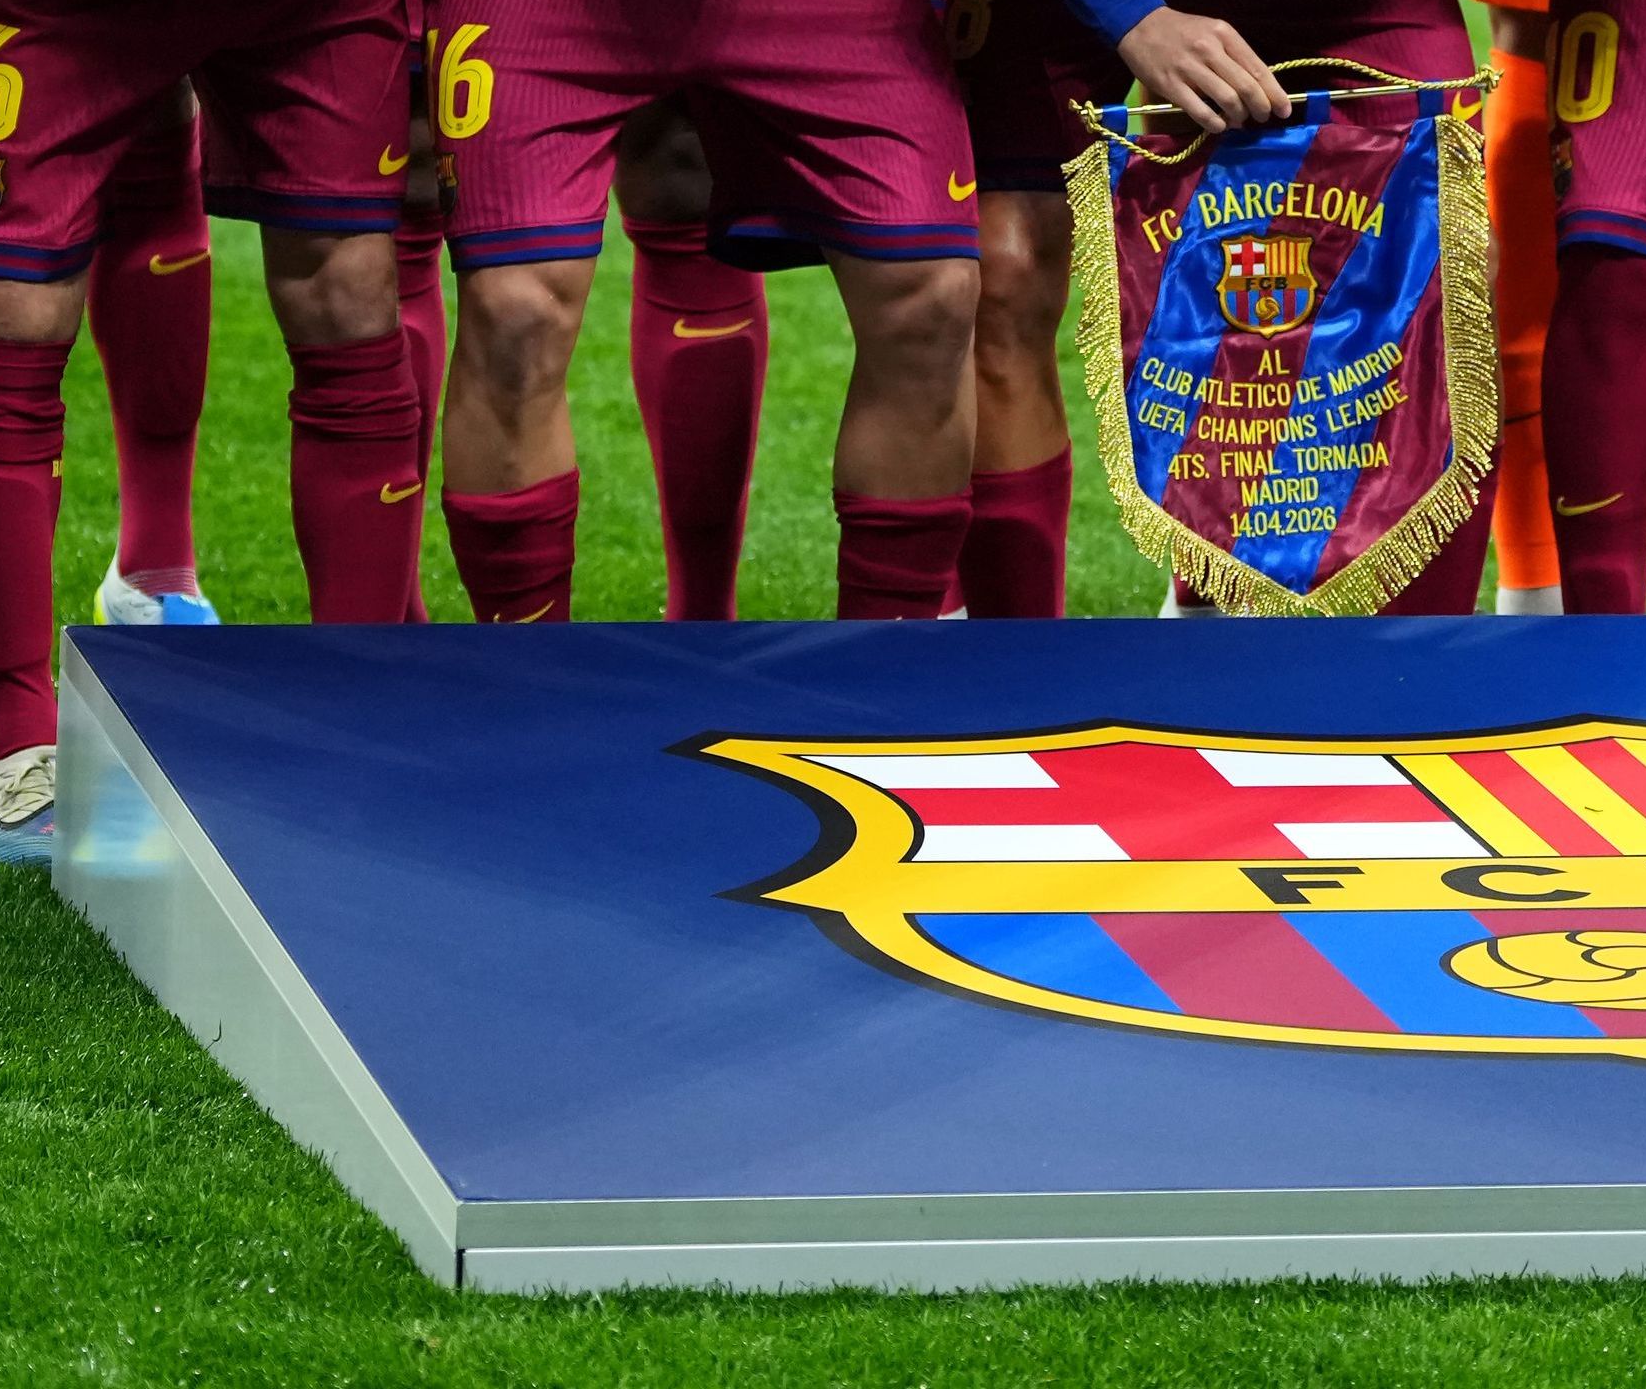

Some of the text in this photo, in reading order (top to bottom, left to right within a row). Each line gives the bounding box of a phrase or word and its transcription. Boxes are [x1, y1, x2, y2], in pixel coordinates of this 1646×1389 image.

[1141, 182, 1385, 253] FC BARCELONA
[1245, 276, 1289, 291] FCB
[1141, 342, 1404, 409] CLUB ATLETICO DE MADRID
[1257, 349, 1290, 376] AL
[1138, 379, 1409, 445] UEFA CHAMPIONS LEAGUE
[1168, 441, 1389, 480] 4TS. FINAL TORNADA
[1241, 476, 1319, 507] MADRID
[1230, 505, 1337, 538] 14.04.2026
